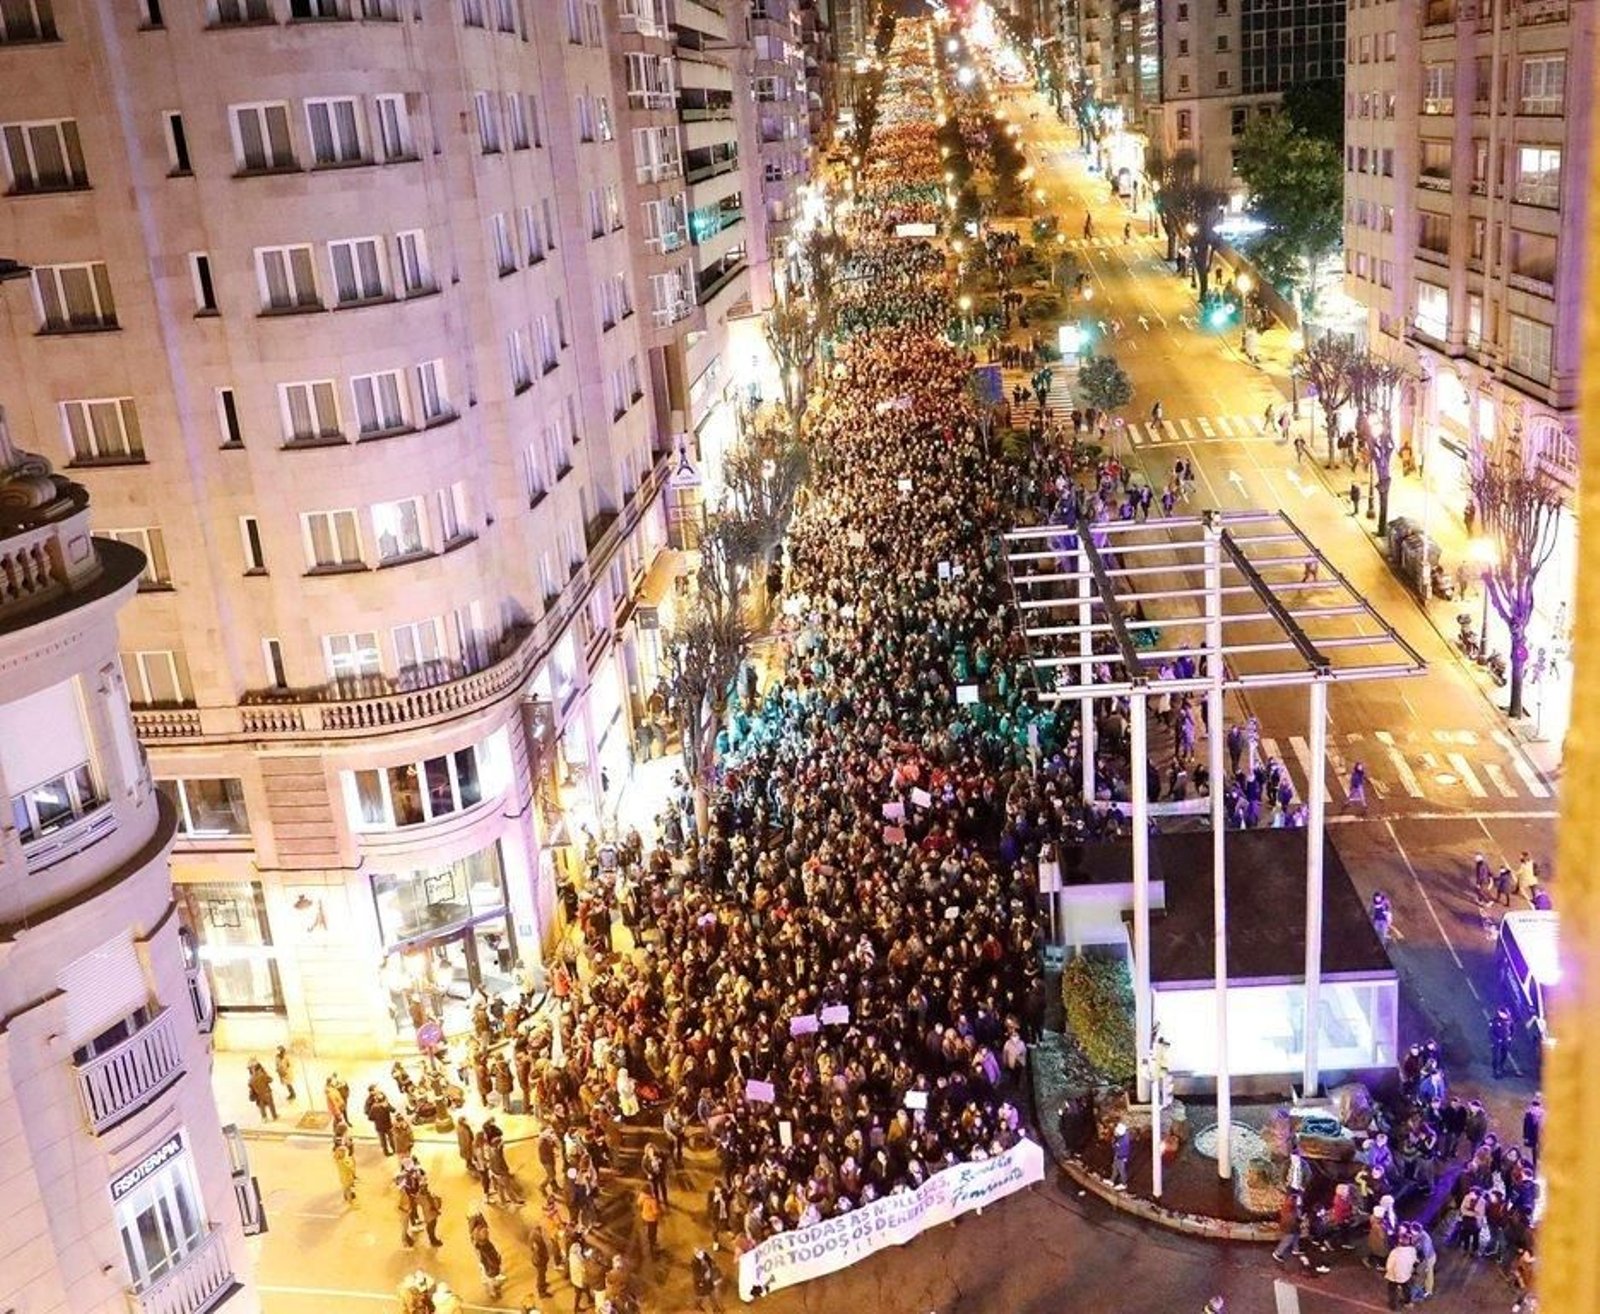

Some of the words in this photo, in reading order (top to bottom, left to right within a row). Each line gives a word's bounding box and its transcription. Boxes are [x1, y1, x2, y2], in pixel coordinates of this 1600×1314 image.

[114, 1140, 179, 1196] FISIOTERAPIA
[755, 1238, 783, 1264] POR
[785, 1219, 846, 1247] TODAS
[850, 1208, 869, 1227] AS
[755, 1255, 785, 1280] POR
[787, 1233, 849, 1264] TODOS
[852, 1221, 872, 1239] OS
